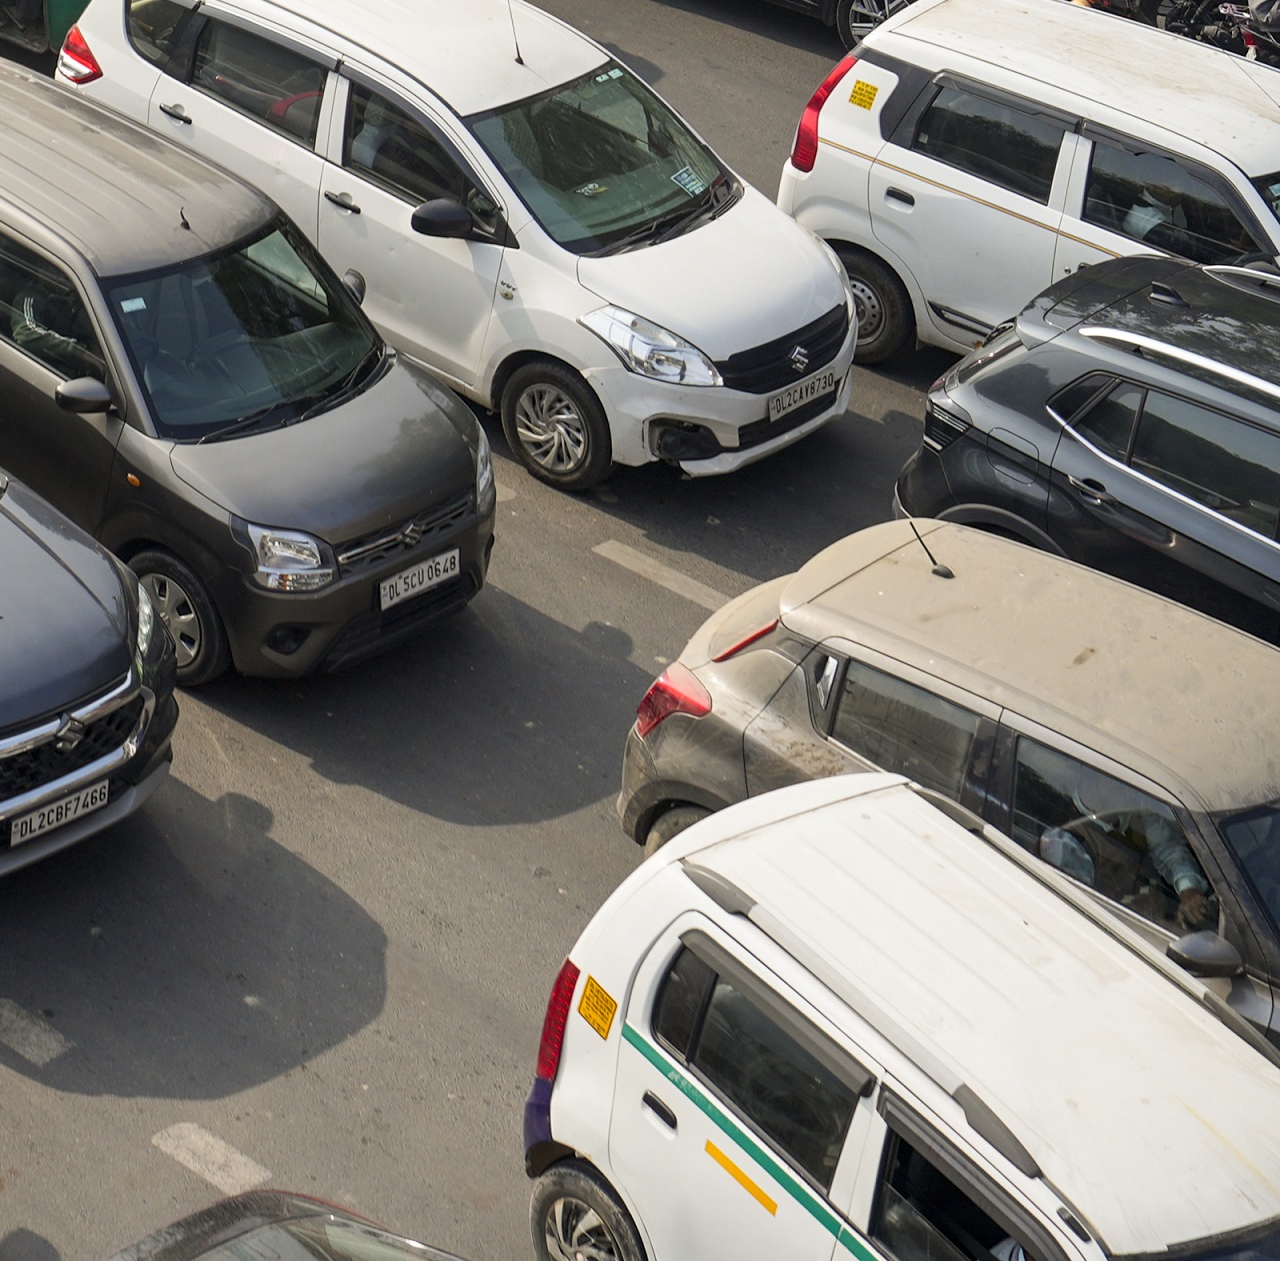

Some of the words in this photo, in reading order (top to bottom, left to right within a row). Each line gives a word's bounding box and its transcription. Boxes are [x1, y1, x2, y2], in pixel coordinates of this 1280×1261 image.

[775, 372, 834, 413] DL2CAY8730
[388, 583, 401, 600] DL
[427, 555, 457, 583] 0648
[19, 784, 107, 838] DL2CBF7466
